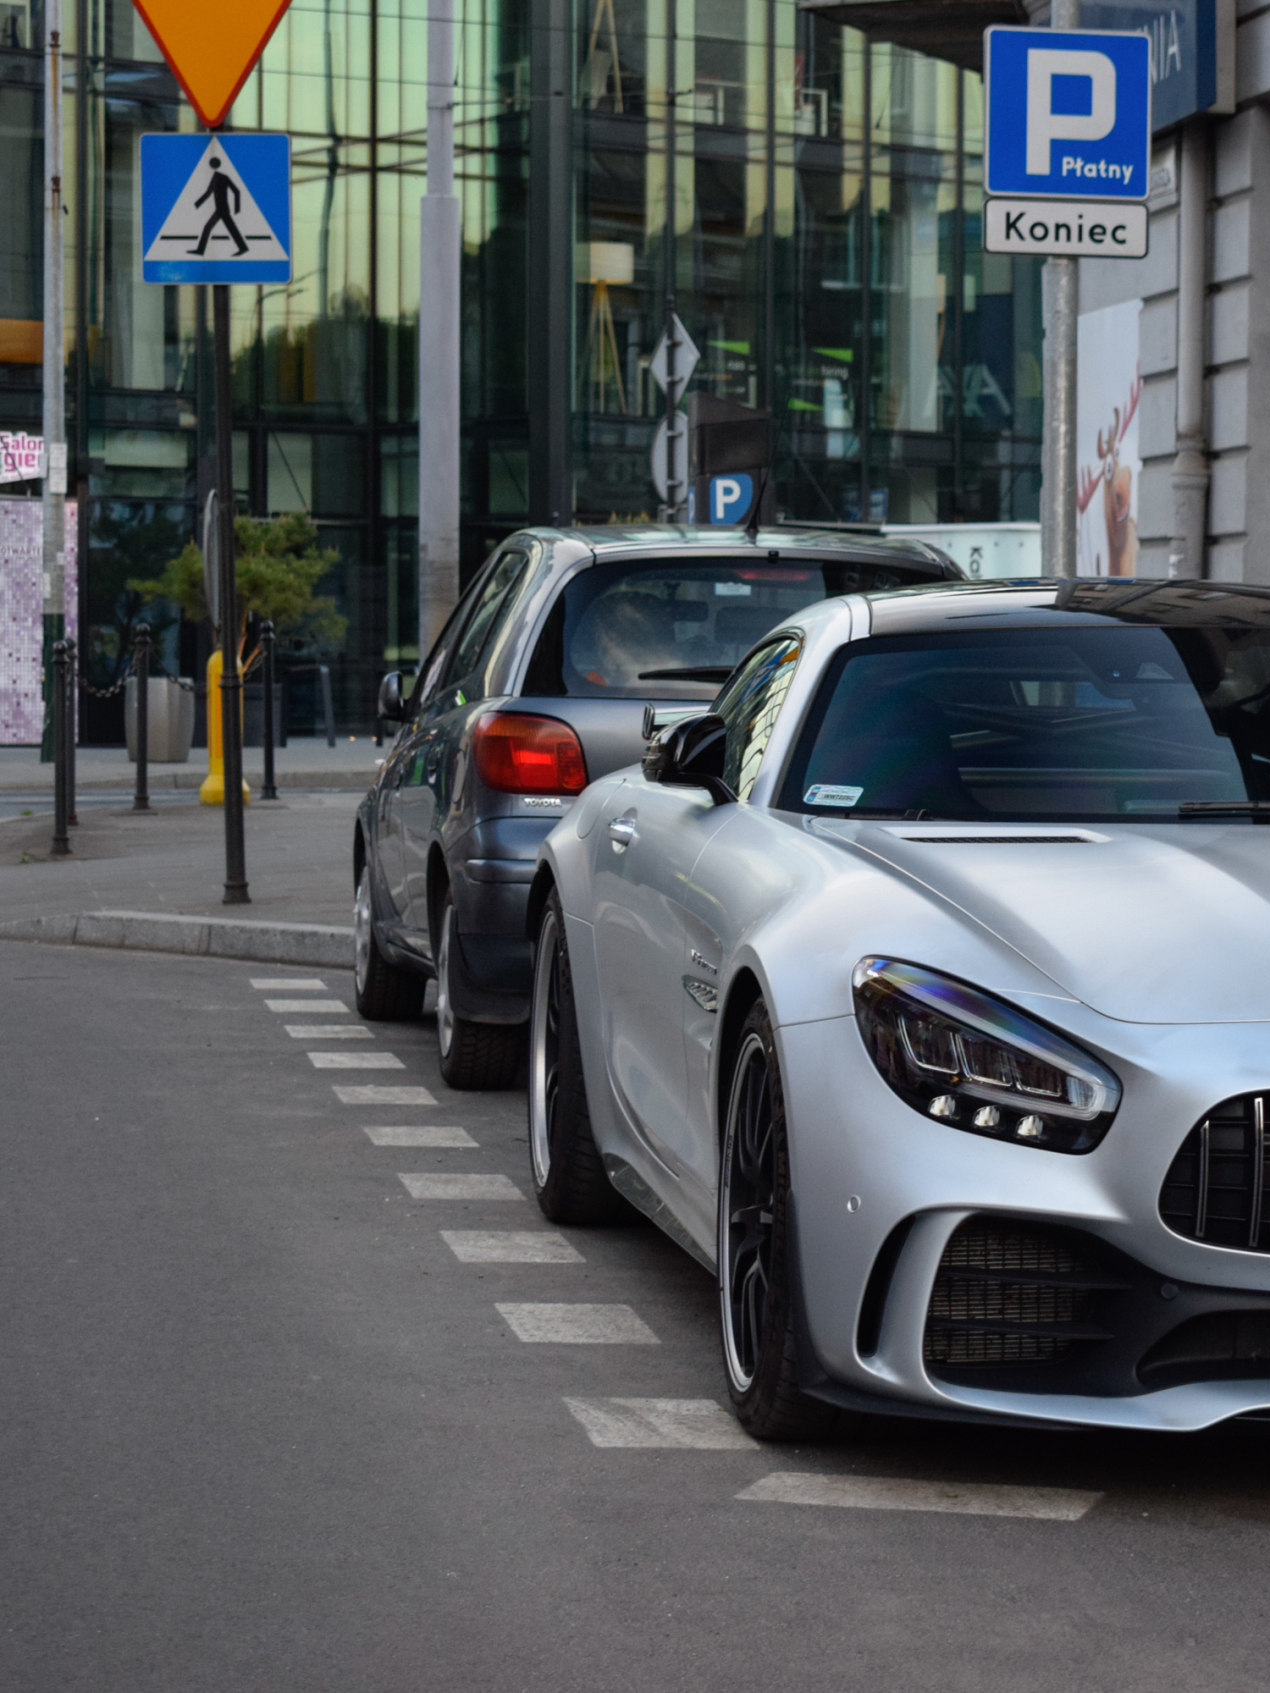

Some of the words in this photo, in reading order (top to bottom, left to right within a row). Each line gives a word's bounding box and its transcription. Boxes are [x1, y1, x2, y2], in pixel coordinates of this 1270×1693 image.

[1026, 48, 1116, 176] P
[1062, 157, 1133, 185] Płatny
[1005, 211, 1127, 245] Koniec
[716, 478, 741, 519] P
[524, 797, 562, 808] TOYOTA
